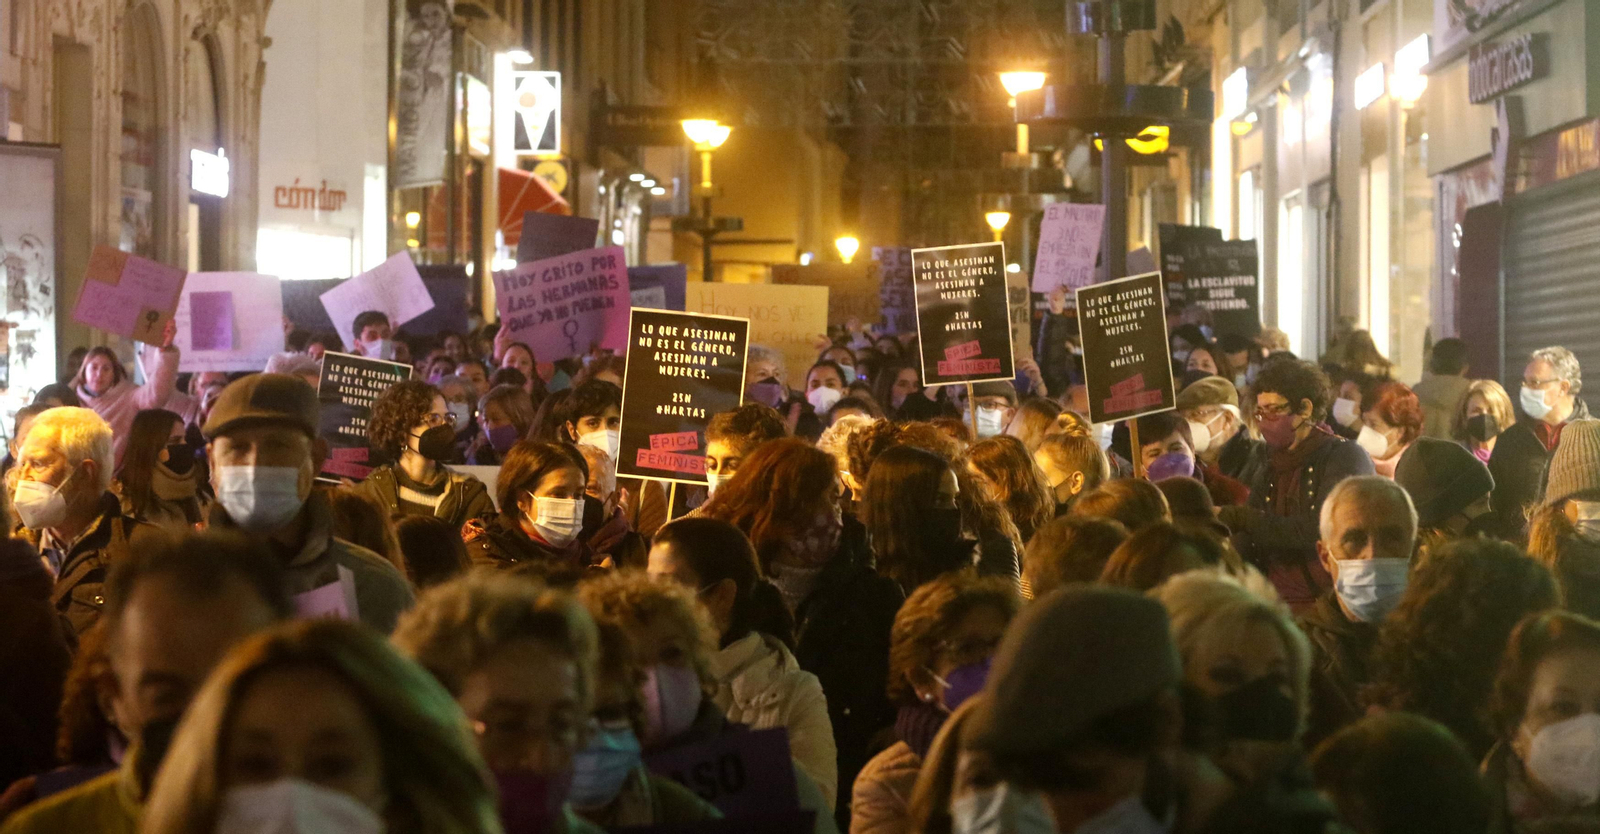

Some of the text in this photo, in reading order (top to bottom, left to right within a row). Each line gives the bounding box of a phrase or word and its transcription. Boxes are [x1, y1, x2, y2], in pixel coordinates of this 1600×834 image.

[922, 255, 995, 270] LO QUE ASESINAN
[502, 272, 536, 292] HOY
[591, 255, 616, 271] POR
[922, 271, 932, 280] NO
[936, 270, 945, 279] ES
[948, 270, 958, 278] EL
[961, 266, 997, 277] GÉNERO,
[935, 278, 985, 290] ASESINAN A
[507, 294, 536, 313] LAS
[541, 274, 619, 303] HERMANAS
[940, 289, 981, 300] MUJERES.
[1086, 299, 1095, 308] LO
[1097, 294, 1112, 306] QUE
[1116, 286, 1153, 301] ASESINAN
[955, 311, 970, 320] 25N
[1085, 309, 1096, 319] NO
[1098, 306, 1109, 316] ES
[1111, 304, 1121, 313] EL
[1099, 309, 1146, 327] ASESINAN A
[642, 323, 736, 342] LO QUE ASESINAN
[638, 336, 736, 357] NO ES EL GÉNERO,
[653, 351, 718, 367] ASESINAN A
[328, 373, 339, 382] NO
[341, 376, 351, 385] ES
[354, 378, 364, 387] EL
[330, 363, 402, 383] LO QUE ASESINAN
[658, 365, 710, 380] MUJERES.
[672, 392, 692, 404] 25N
[656, 405, 706, 419] #HARTAS
[651, 434, 697, 449] ÉPICA
